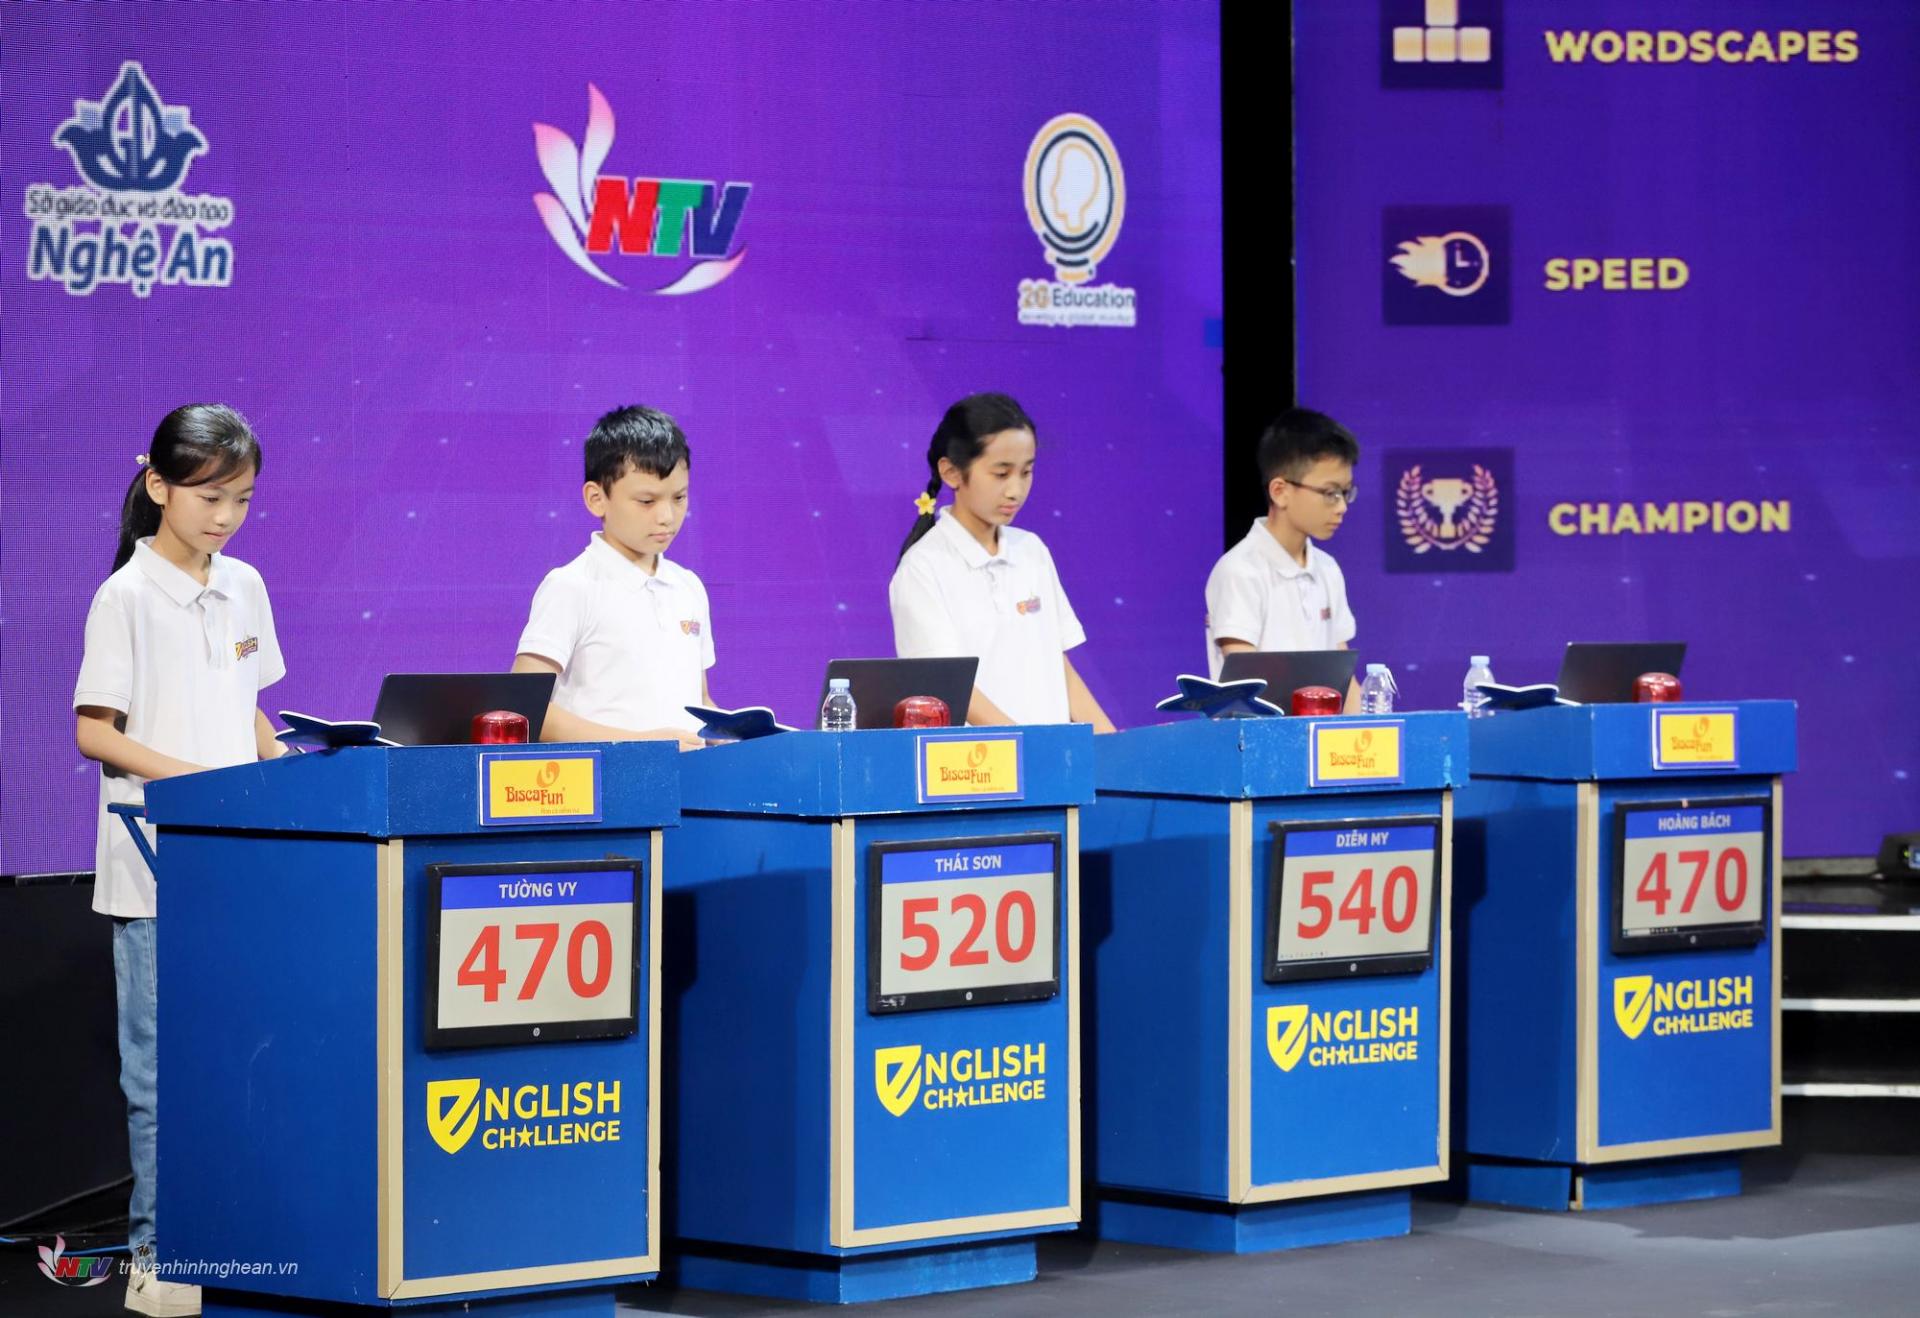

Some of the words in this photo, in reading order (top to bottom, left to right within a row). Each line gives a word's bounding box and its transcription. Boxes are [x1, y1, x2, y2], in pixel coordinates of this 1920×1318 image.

[1544, 30, 1860, 63] WORDSCAPES
[585, 175, 752, 258] NTV
[33, 225, 157, 293] Nghệ
[167, 232, 230, 281] An
[1544, 258, 1690, 290] SPEED
[1052, 287, 1136, 309] Education
[1548, 500, 1792, 535] CHAMPION
[1700, 812, 1731, 829] BÁCH
[1370, 832, 1389, 846] MY
[935, 853, 969, 872] THÁI
[972, 854, 1002, 870] SƠN
[499, 878, 553, 899] TƯỜNG
[557, 881, 577, 896] VY
[1636, 847, 1748, 916] 470
[1297, 865, 1418, 940] 540
[900, 890, 1036, 972] 520
[457, 920, 613, 1003] 470
